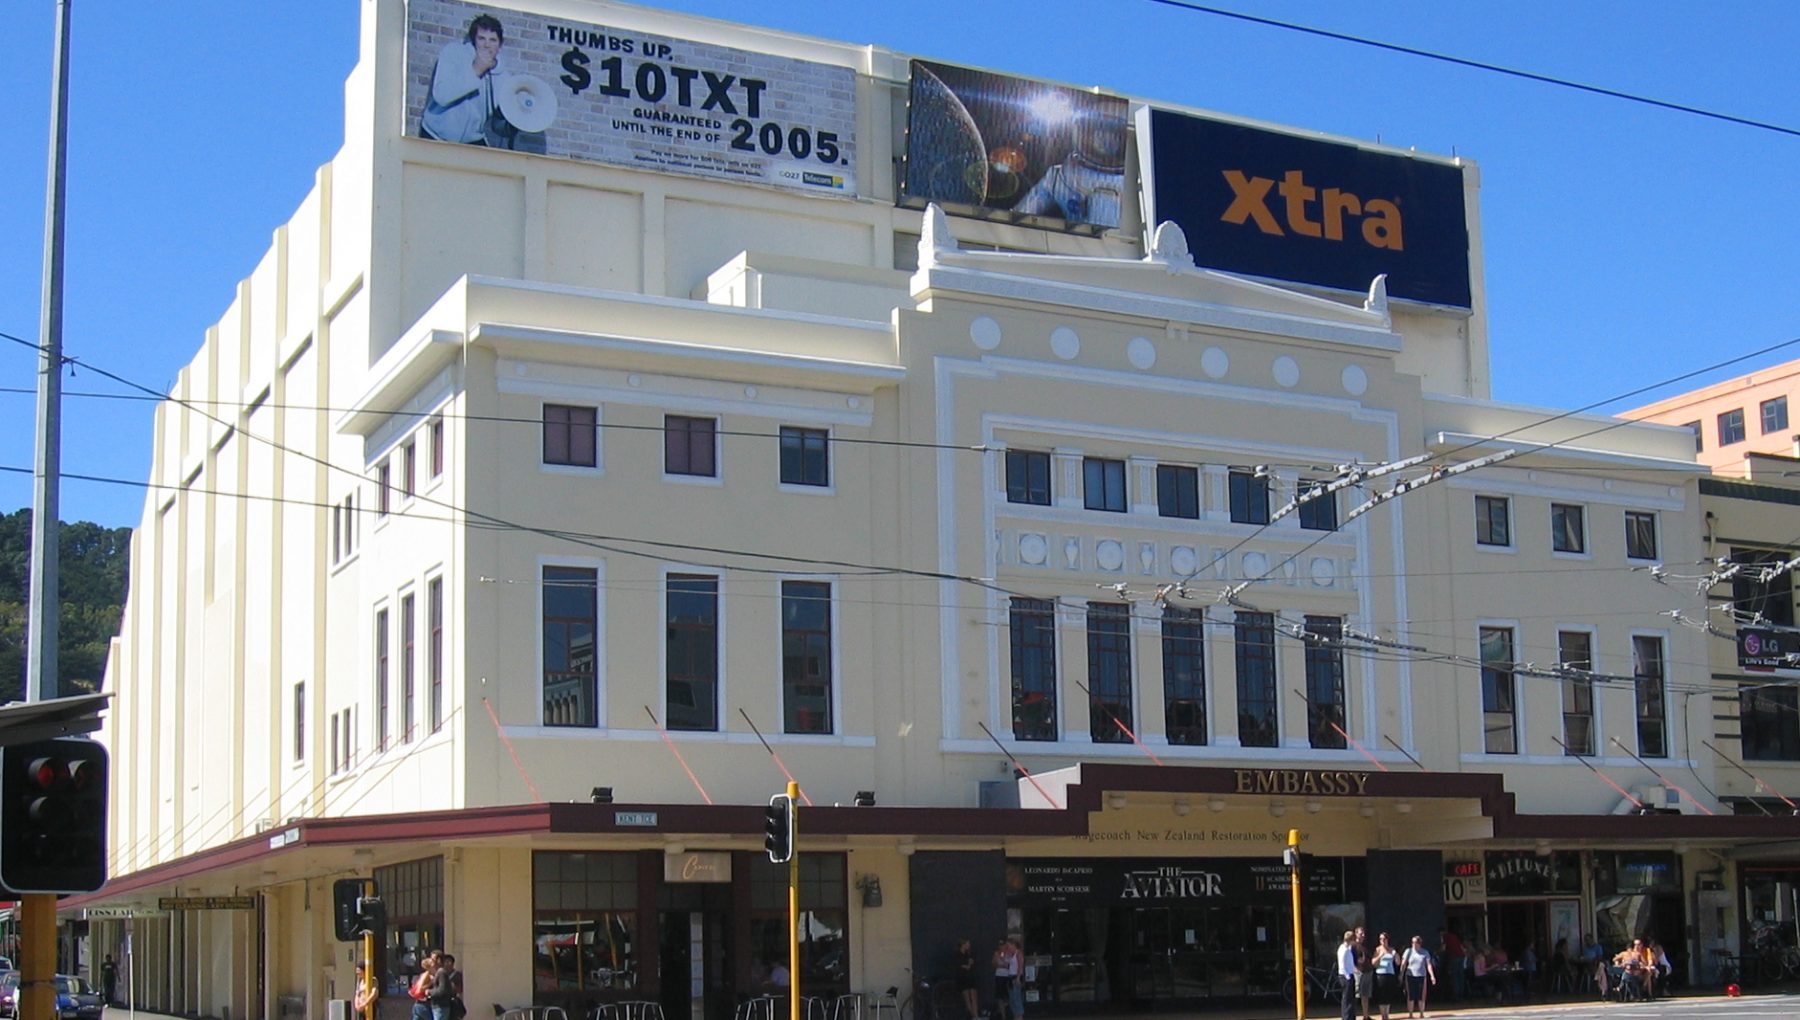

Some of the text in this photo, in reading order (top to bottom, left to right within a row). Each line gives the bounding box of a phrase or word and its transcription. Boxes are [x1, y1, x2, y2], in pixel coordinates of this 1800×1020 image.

[547, 25, 674, 60] THUMBS UP.
[560, 46, 767, 118] $10TXT
[633, 108, 722, 129] GUARANTEED
[612, 119, 721, 143] UNTIL THE END OF
[730, 118, 849, 165] 2005.
[1220, 170, 1403, 250] xtra
[1762, 639, 1778, 652] LG
[1234, 770, 1370, 794] EMBASSY
[1137, 830, 1158, 840] New
[1164, 830, 1205, 841] Zealand
[1212, 830, 1267, 841] Restoration
[1272, 830, 1310, 842] Spoor
[1158, 867, 1182, 877] THE
[1455, 863, 1479, 875] CAFE
[1498, 858, 1551, 879] DELUXE
[1120, 873, 1226, 898] AVIATOR
[1444, 879, 1464, 900] 10
